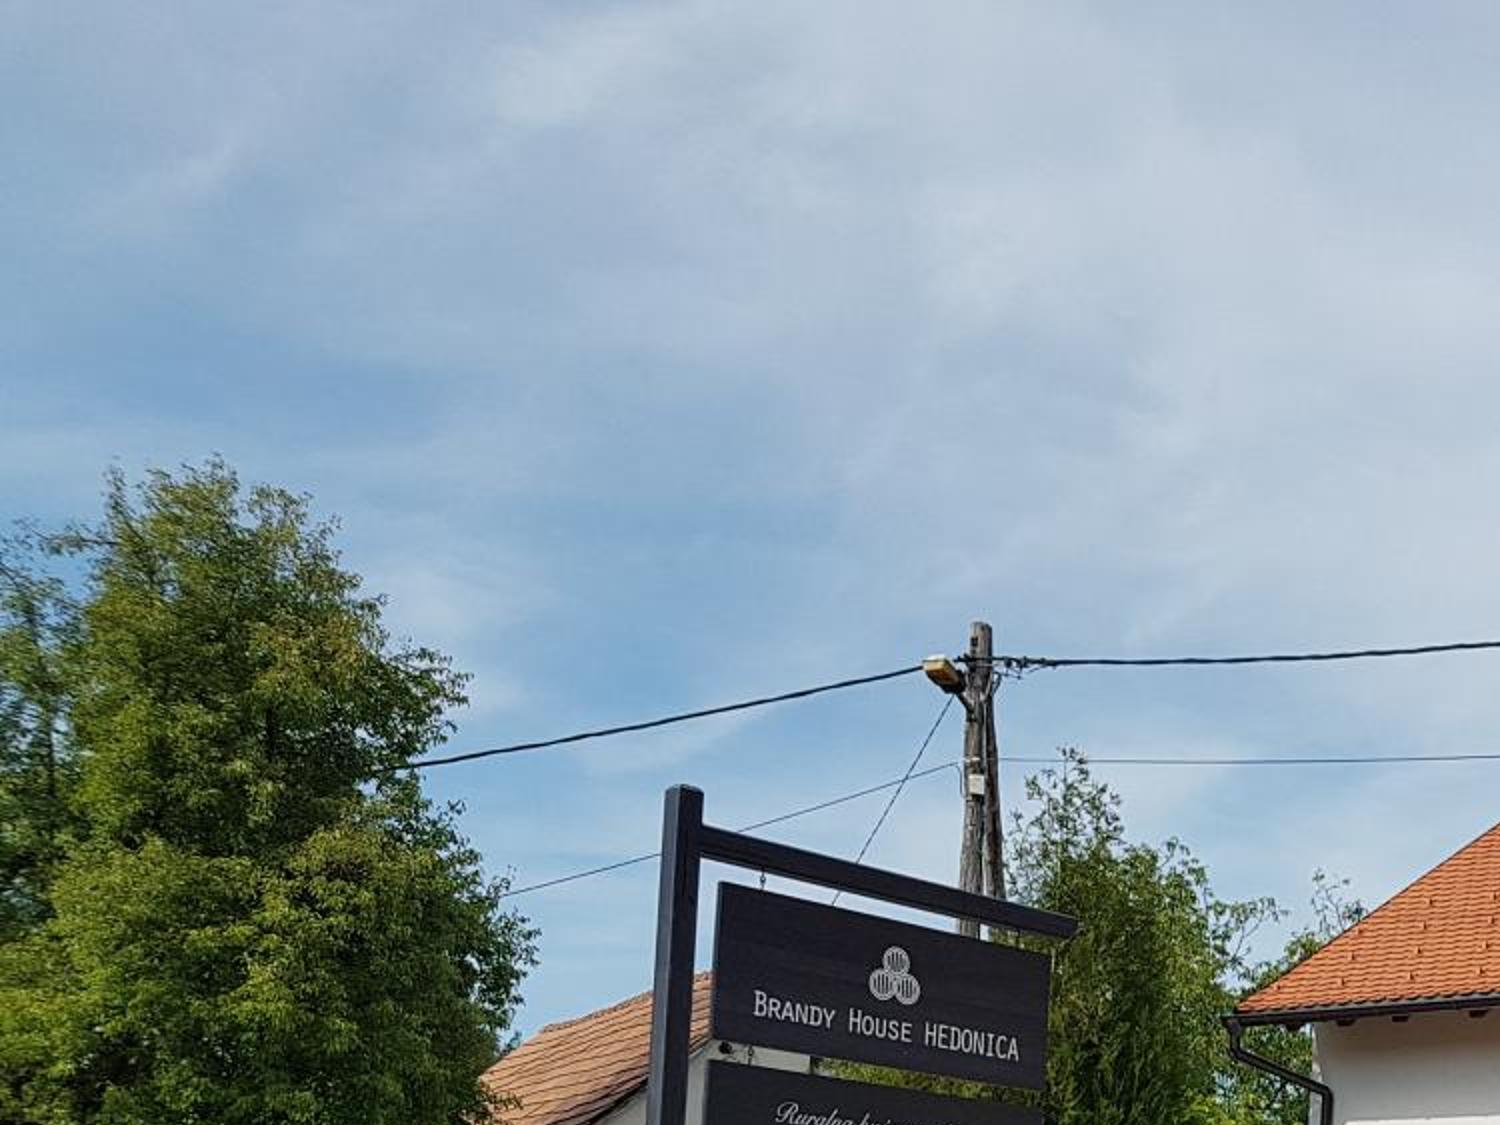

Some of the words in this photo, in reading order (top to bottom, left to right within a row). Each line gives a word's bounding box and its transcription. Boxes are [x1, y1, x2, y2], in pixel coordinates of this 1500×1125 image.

[753, 989, 836, 1029] BRANDY
[848, 1007, 913, 1043] HOUSE
[924, 1020, 1020, 1062] HEDONICA
